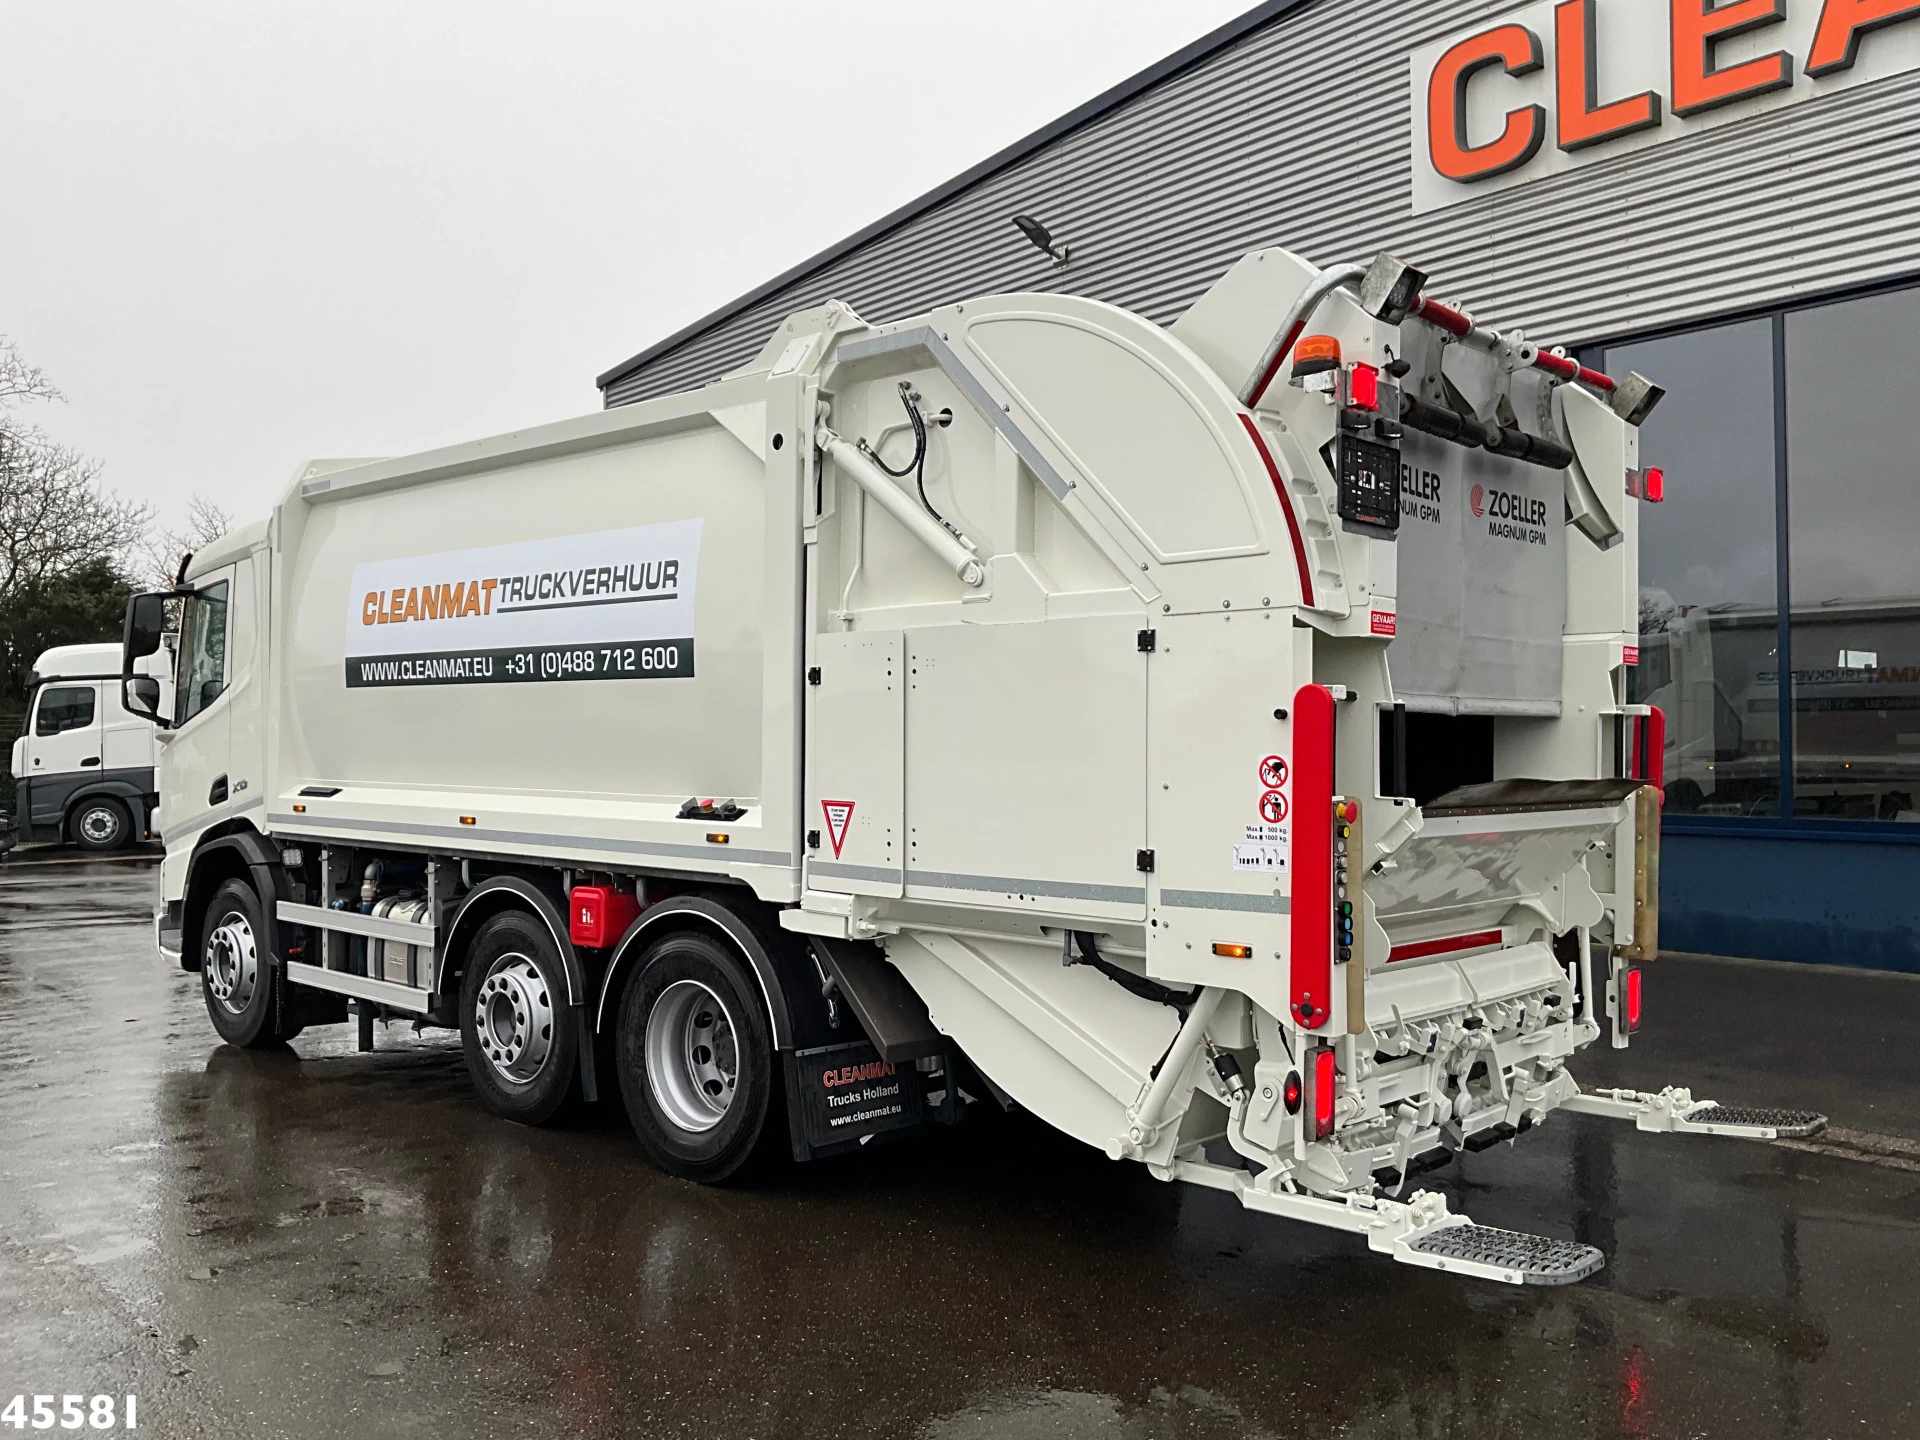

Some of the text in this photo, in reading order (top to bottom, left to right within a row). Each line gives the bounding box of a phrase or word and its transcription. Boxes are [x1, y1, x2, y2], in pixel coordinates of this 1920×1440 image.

[1400, 463, 1441, 503] ELLER
[1420, 502, 1440, 524] GPM
[1488, 489, 1547, 527] ZOELLER
[1488, 521, 1547, 546] MAGNUM GPM
[362, 559, 679, 626] CLEANMAT TRUCKVERHUUR
[361, 646, 679, 681] WWW.CLEANMAT.EU +31 (0)488 712 600
[827, 1083, 900, 1107] Trucks Holland
[830, 1104, 902, 1127] www.cleanmat.eu
